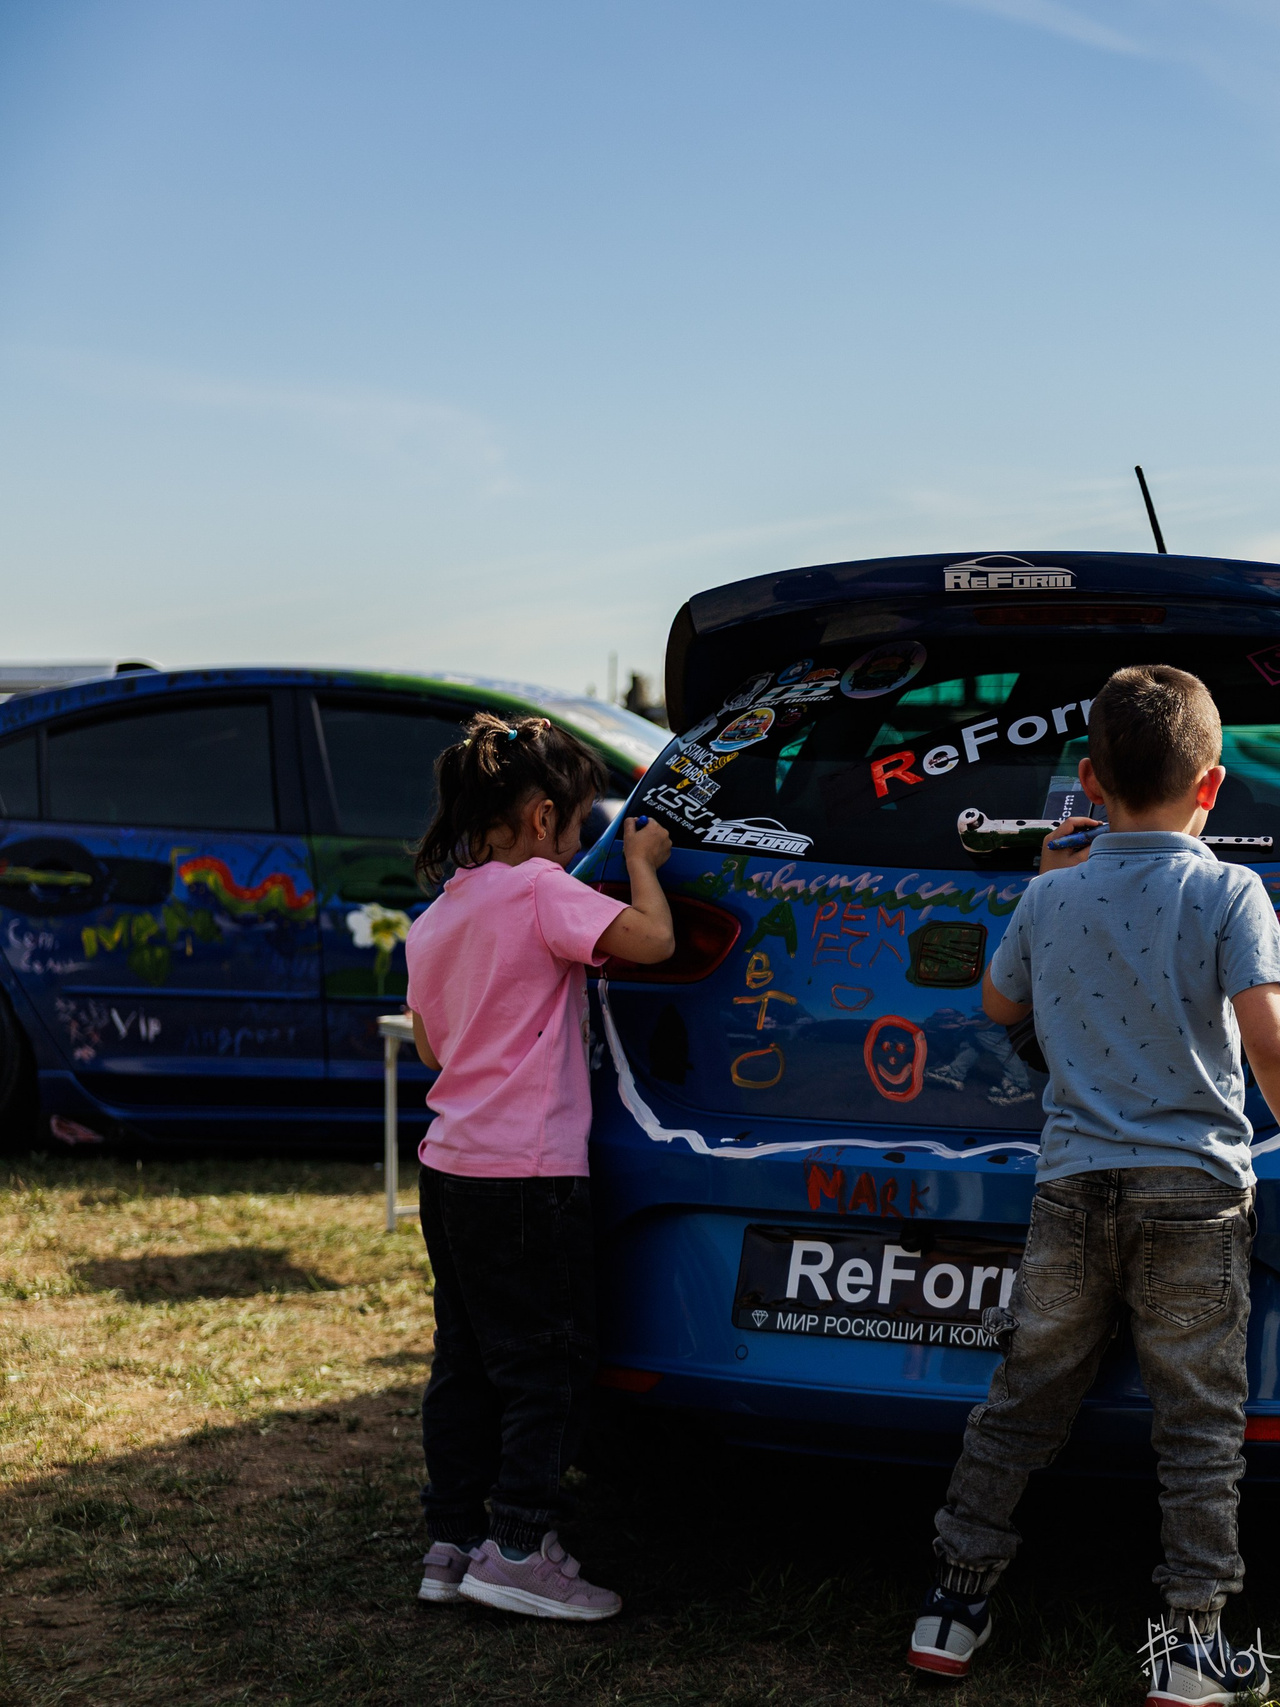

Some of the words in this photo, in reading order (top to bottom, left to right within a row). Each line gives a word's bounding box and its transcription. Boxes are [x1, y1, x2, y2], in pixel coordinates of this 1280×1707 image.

[665, 753, 709, 785] BAZZTARDS
[682, 743, 719, 769] STANCE
[776, 1312, 819, 1332] МИР
[824, 1315, 922, 1341] РОСКОШИ
[929, 1324, 943, 1342] И
